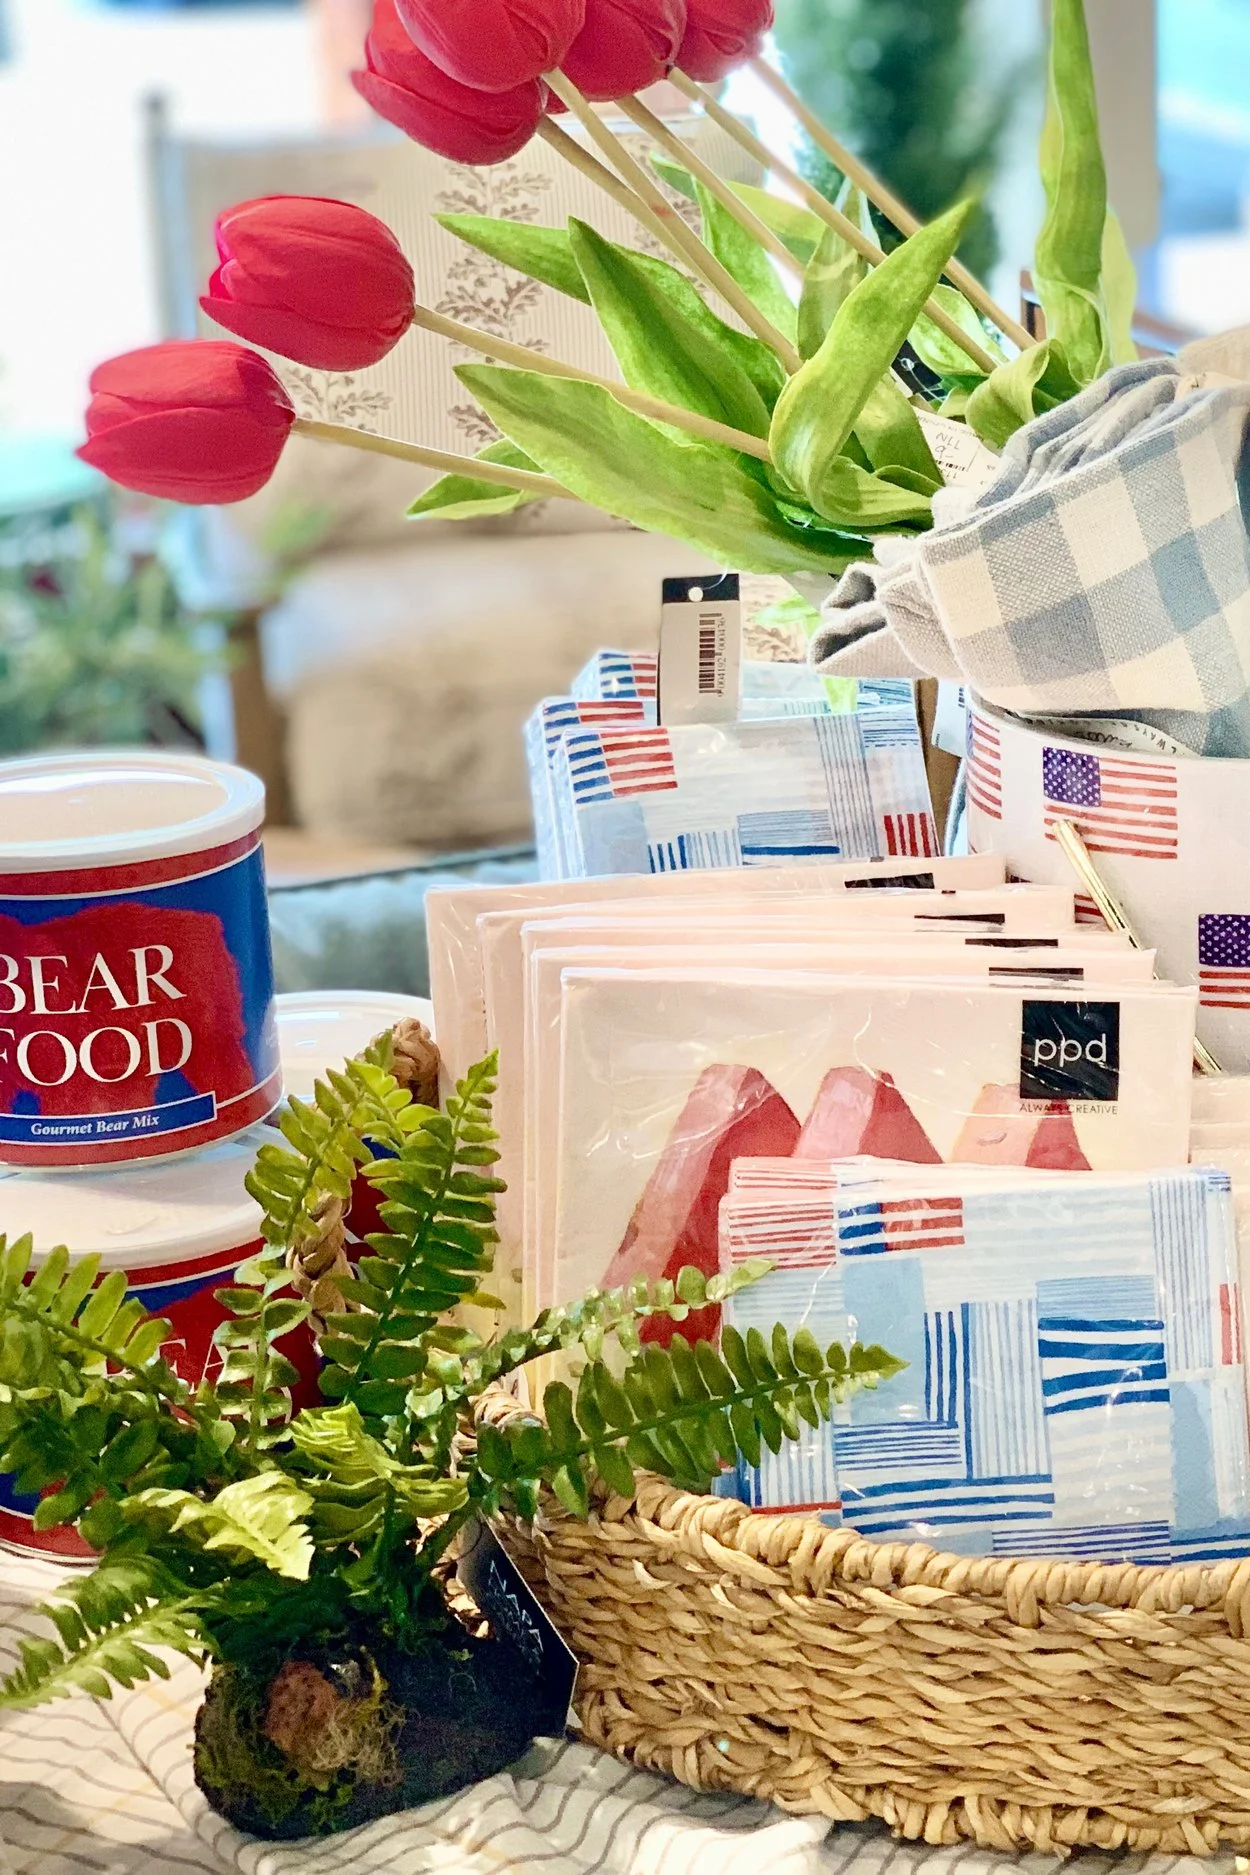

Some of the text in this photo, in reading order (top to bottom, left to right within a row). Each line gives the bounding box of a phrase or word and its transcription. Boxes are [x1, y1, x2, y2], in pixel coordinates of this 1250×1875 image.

[1034, 1033, 1108, 1067] ppd
[30, 1115, 160, 1136] Gourmet Bear Mix
